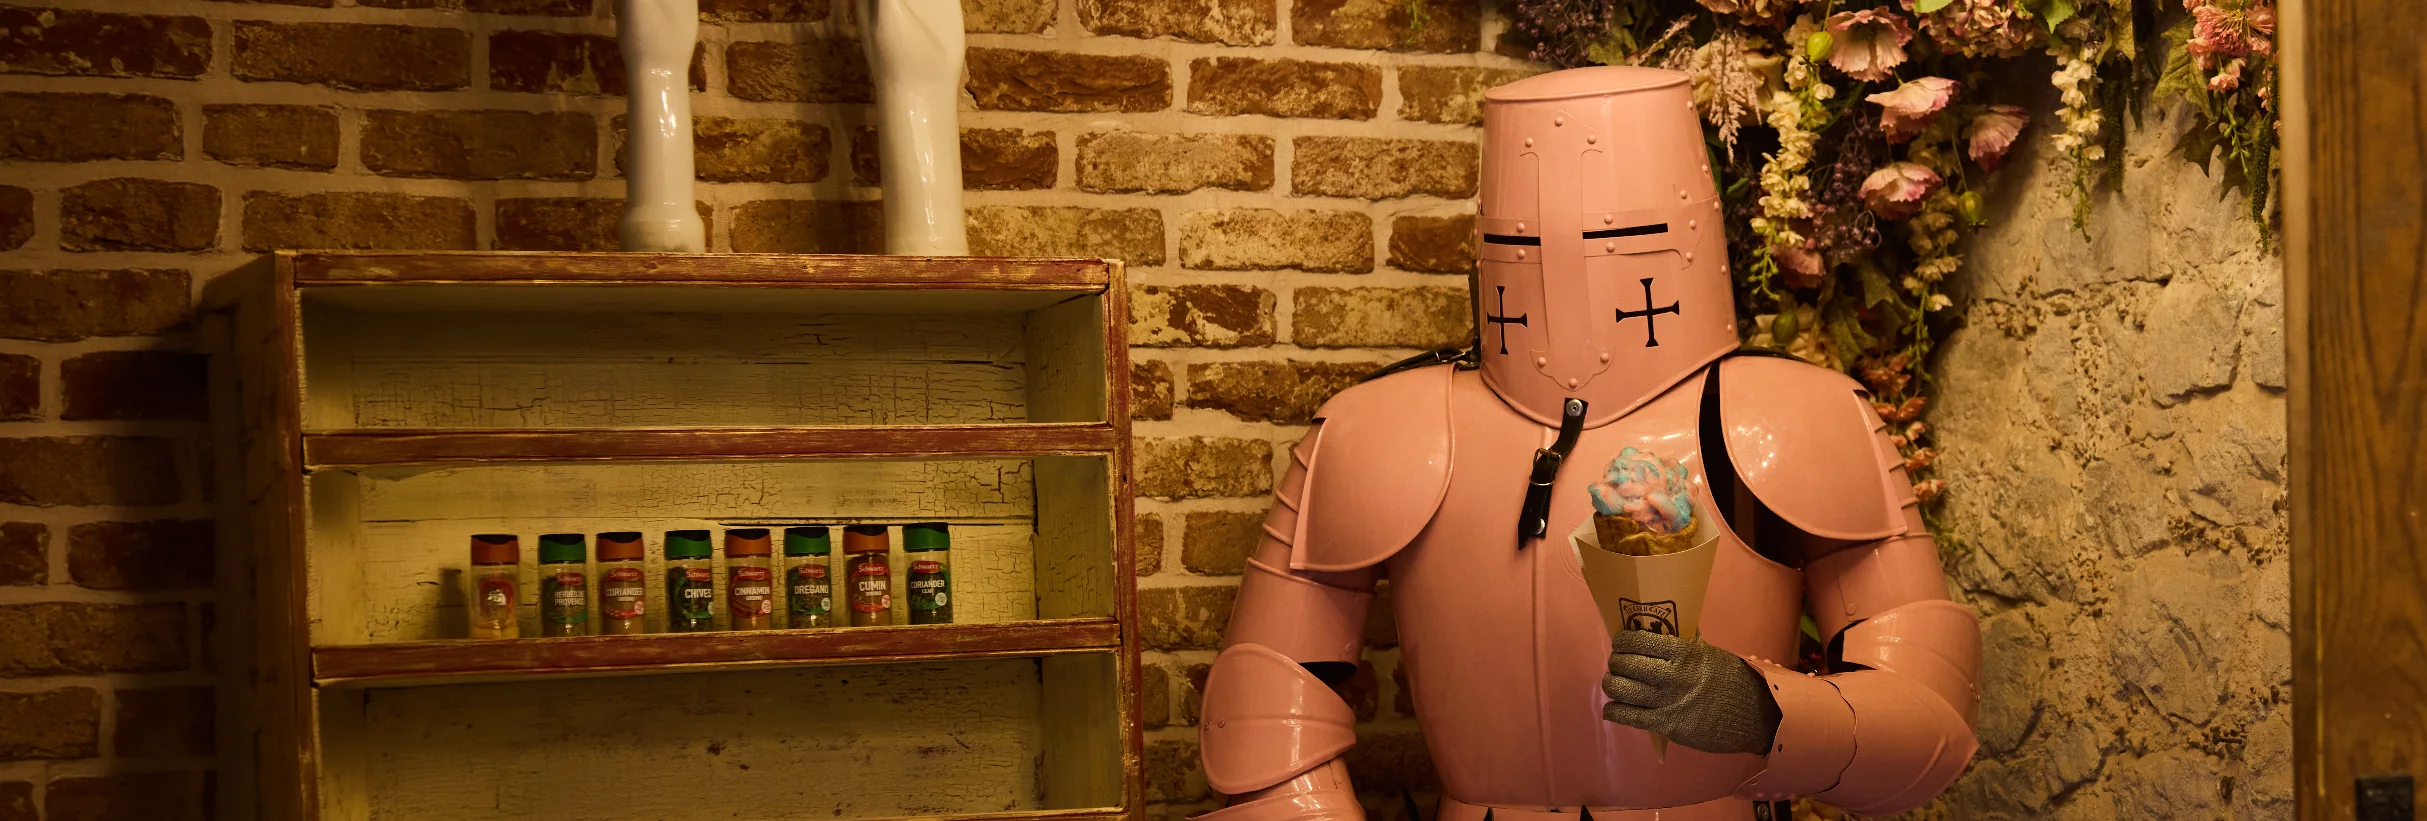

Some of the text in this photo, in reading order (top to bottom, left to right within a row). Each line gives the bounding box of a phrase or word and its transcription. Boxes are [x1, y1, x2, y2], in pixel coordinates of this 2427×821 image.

[858, 565, 884, 573] Schwartz
[912, 562, 939, 571] Schwartz
[858, 580, 886, 592] CUMIN
[911, 580, 945, 588] CORIANDER
[605, 587, 644, 597] CORIANDER
[684, 588, 712, 599] CHIVES
[734, 586, 770, 596] CINNAMON
[794, 584, 829, 595] OREGANO
